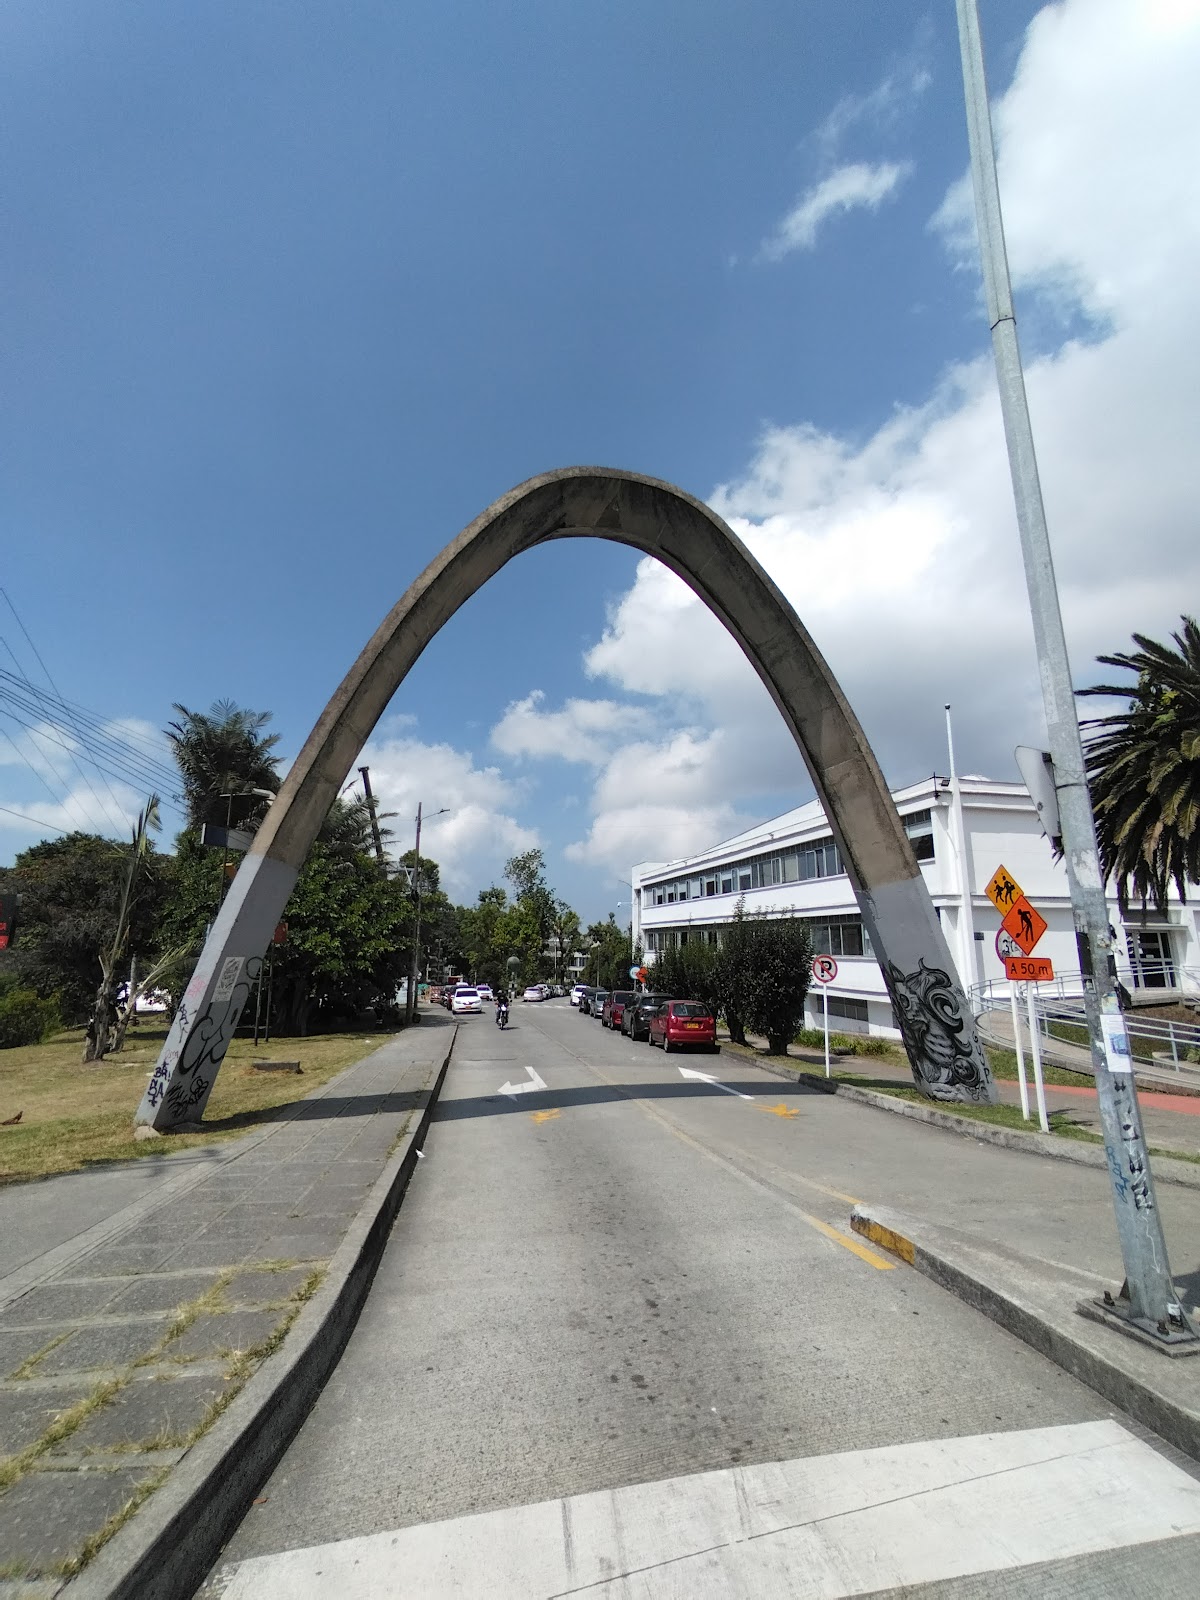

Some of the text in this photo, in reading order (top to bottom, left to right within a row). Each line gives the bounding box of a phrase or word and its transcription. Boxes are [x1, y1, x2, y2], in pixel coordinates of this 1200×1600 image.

[821, 960, 832, 978] P
[1010, 962, 1049, 975] A 50 m
